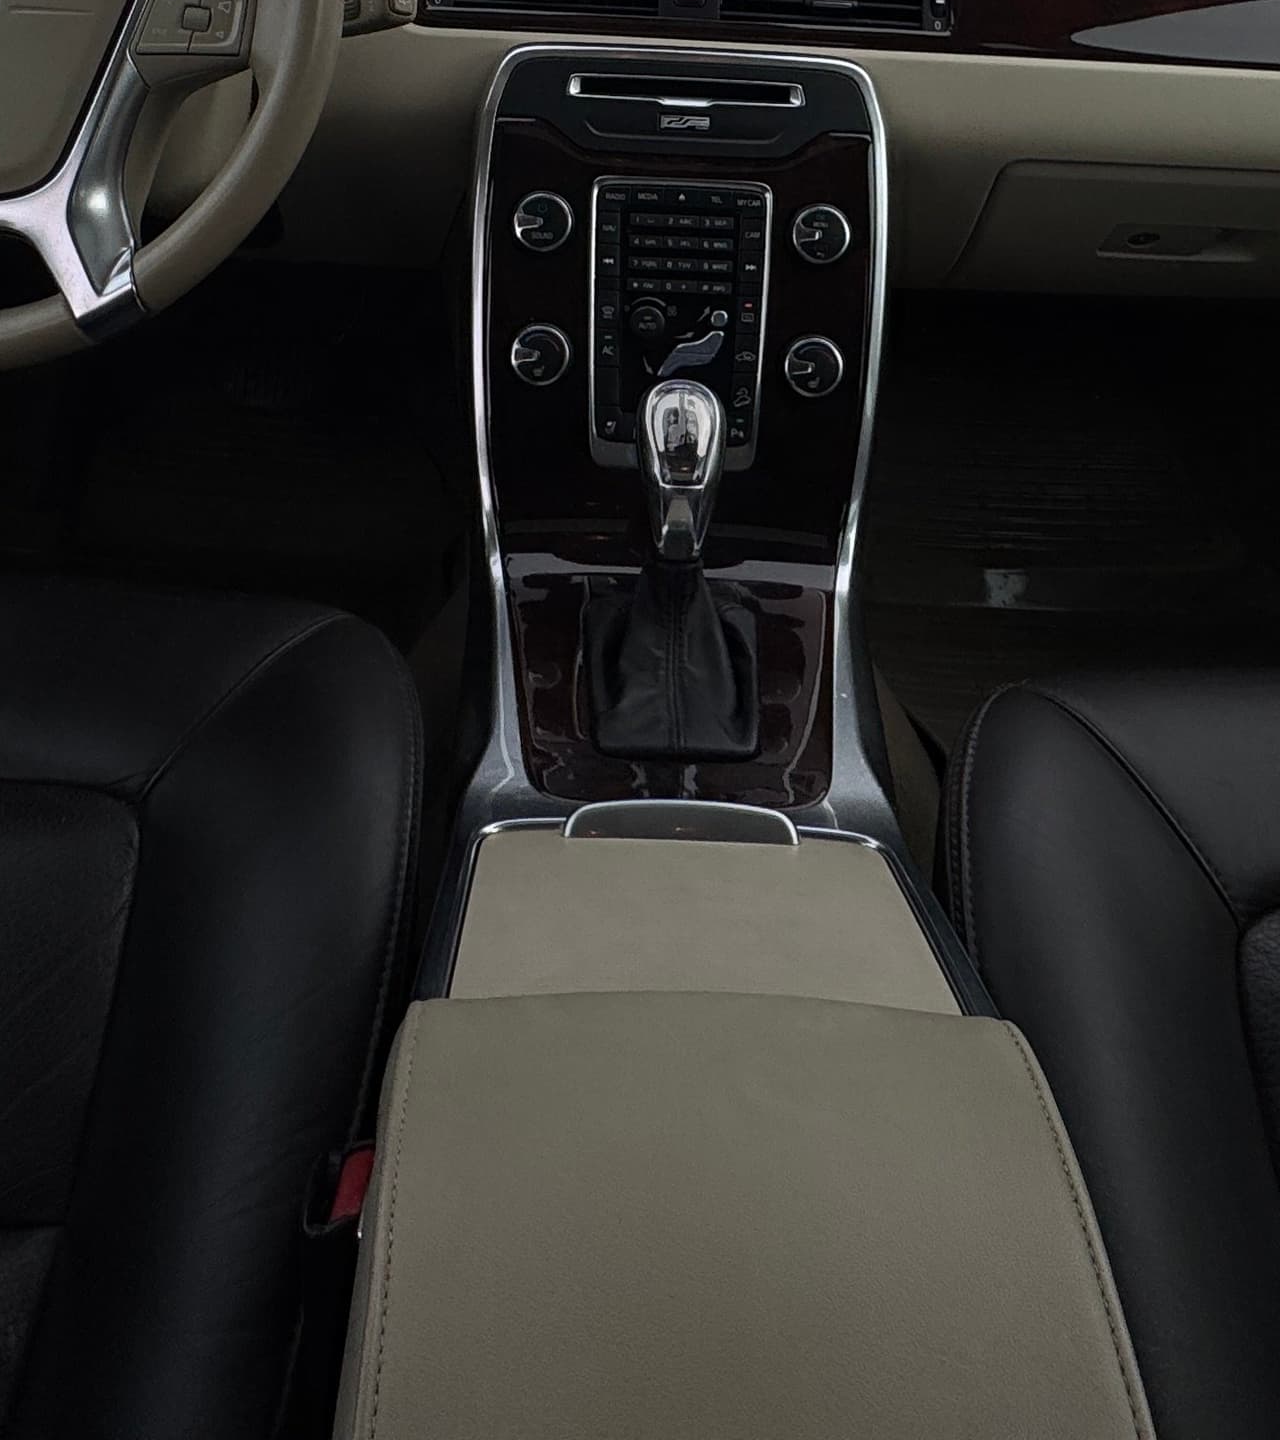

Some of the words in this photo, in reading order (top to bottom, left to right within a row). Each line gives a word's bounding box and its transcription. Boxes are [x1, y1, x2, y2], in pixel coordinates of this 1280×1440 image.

[604, 192, 627, 202] RADIO
[637, 192, 659, 202] MEDIA
[748, 199, 762, 208] CAR
